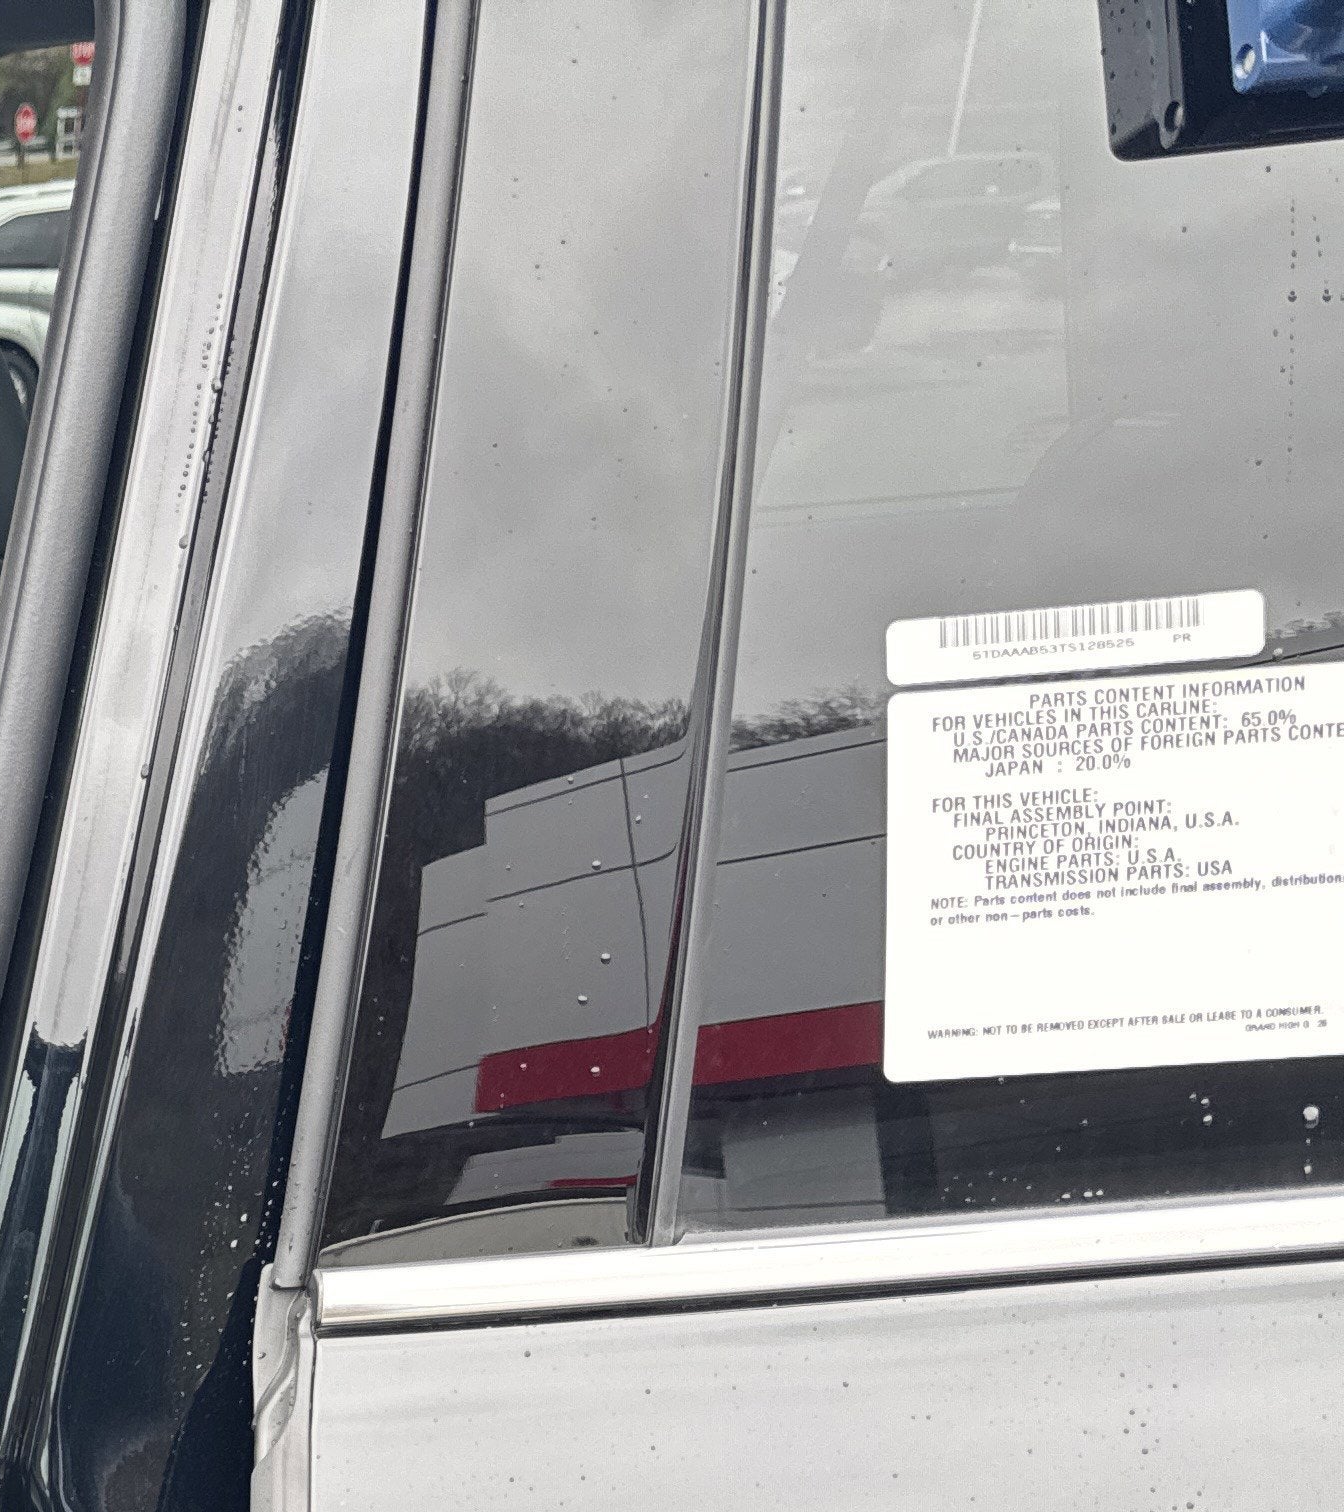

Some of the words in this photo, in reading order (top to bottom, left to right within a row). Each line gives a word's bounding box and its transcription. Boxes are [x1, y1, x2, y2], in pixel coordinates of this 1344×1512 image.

[1173, 634, 1191, 642] PR
[1029, 691, 1087, 709] PARTS
[1094, 685, 1175, 704] CONTENT
[1183, 676, 1305, 698] INFORMATION
[933, 716, 965, 732] FOR
[974, 709, 1056, 729] VEHICLES
[1065, 708, 1081, 723] IN
[1090, 705, 1129, 721] THIS
[1137, 700, 1217, 718] CARLINE:
[954, 725, 1068, 747] U.S./CANADA
[1077, 721, 1133, 738] PARTS
[1141, 714, 1227, 735] CONTENT:
[954, 745, 1014, 763] MAJOR
[1023, 739, 1103, 758] SOURCES
[1111, 737, 1133, 752] OF
[1141, 732, 1215, 751] FOREIGN
[1224, 727, 1281, 745] PARTS
[985, 760, 1042, 778] JAPAN
[1075, 754, 1131, 772] 20.0%
[932, 797, 965, 813] FOR
[973, 793, 1012, 810] THIS
[1020, 788, 1098, 807] VEHICLE:
[954, 811, 1003, 828] FINAL
[1011, 803, 1106, 823] ASSEMBLY
[1113, 799, 1172, 816] POINT:
[986, 822, 1091, 841] PRINCETON,
[1099, 816, 1177, 834] INDIANA,
[1186, 811, 1239, 829] U.S.A.
[953, 841, 1035, 860] COUNTRY
[1044, 839, 1065, 854] OF
[1072, 835, 1138, 852] ORIGIN:
[985, 856, 1049, 874] ENGINE
[1057, 851, 1120, 869] PARTS:
[1128, 848, 1181, 865] U.S.A.
[985, 868, 1118, 890] TRANSMISSION
[1127, 863, 1190, 881] PARTS:
[1197, 860, 1232, 877] USA
[931, 896, 968, 909] NOTE:
[974, 895, 1005, 907] Parts
[1011, 891, 1057, 903] content
[1062, 889, 1091, 900] does
[1097, 888, 1116, 898] not
[1121, 884, 1166, 897] include
[1172, 882, 1197, 893] final
[1203, 878, 1265, 891] assembly,
[1272, 873, 1344, 887] distribution
[931, 916, 943, 925] or
[948, 913, 980, 925] other
[1058, 906, 1094, 917] costs.
[983, 1025, 1001, 1036] NOT
[1006, 1025, 1017, 1034] TO
[1021, 1024, 1032, 1033] BE
[1037, 1021, 1084, 1032] REMOVED
[1088, 1018, 1124, 1029] EXCEPT
[1128, 1016, 1158, 1026] AFTER
[1162, 1014, 1185, 1024] SALE
[1189, 1013, 1203, 1022] OR
[1207, 1011, 1236, 1021] LEASE
[1241, 1010, 1252, 1019] TO
[1256, 1009, 1262, 1018] A
